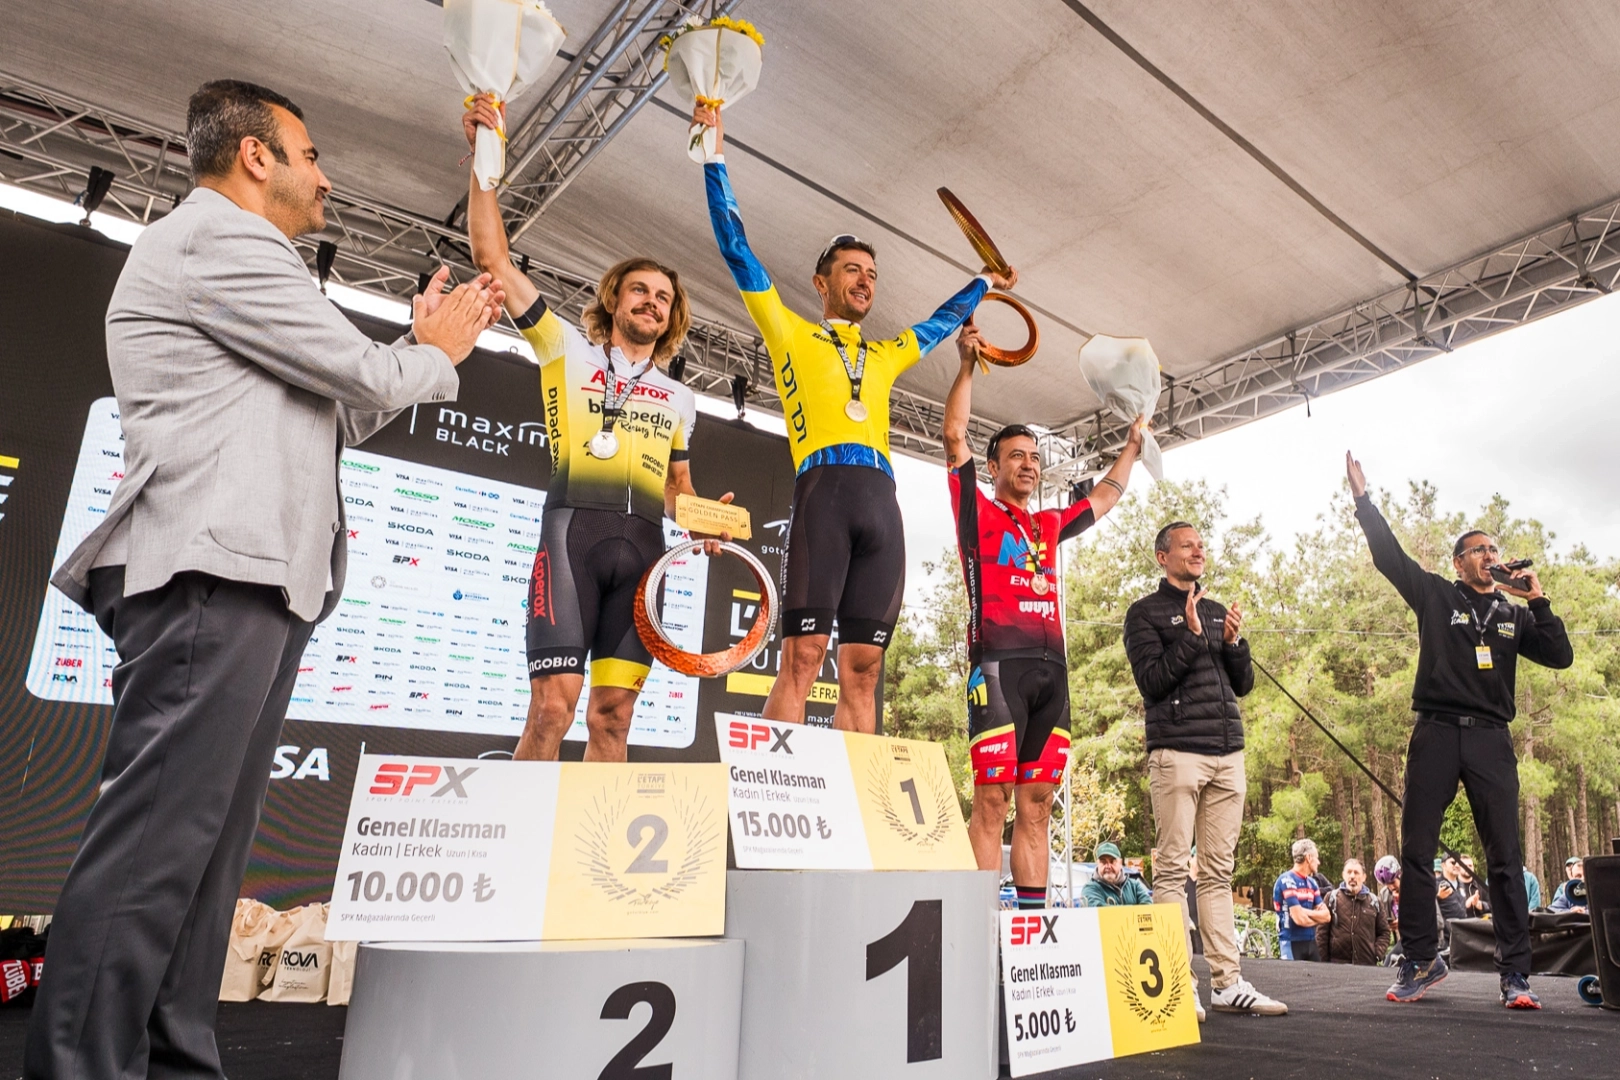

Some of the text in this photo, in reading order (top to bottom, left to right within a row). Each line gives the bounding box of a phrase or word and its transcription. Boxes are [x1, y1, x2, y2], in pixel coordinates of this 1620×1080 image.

[436, 427, 509, 456] BLACK
[688, 506, 738, 523] GOLDEN PASS
[670, 529, 690, 540] SPX
[392, 554, 419, 566] SPX
[533, 550, 546, 618] Asperox
[336, 654, 358, 664] SPX
[409, 691, 430, 699] SPX
[728, 721, 794, 755] SPX
[368, 763, 480, 798] SPX
[730, 765, 827, 790] Genel Klasman
[986, 766, 1006, 778] NF
[1024, 768, 1043, 779] NF
[732, 787, 760, 800] Kadın
[765, 788, 792, 803] Erkek
[899, 777, 926, 825] 1
[357, 816, 506, 839] Genel Klasman
[737, 810, 812, 839] 15.000
[351, 842, 393, 857] Kadın
[403, 843, 443, 858] Erkek
[624, 813, 669, 874] 2
[347, 870, 464, 902] 10.000
[1010, 915, 1060, 946] SPX
[280, 950, 318, 969] ROVA
[865, 898, 943, 1064] 1
[1010, 962, 1082, 983] Genel Klasman
[1139, 948, 1164, 998] 3
[1011, 988, 1032, 1001] Kadın
[1036, 985, 1055, 999] Erkek
[596, 980, 677, 1080] 2
[1014, 1009, 1060, 1042] 5.000
